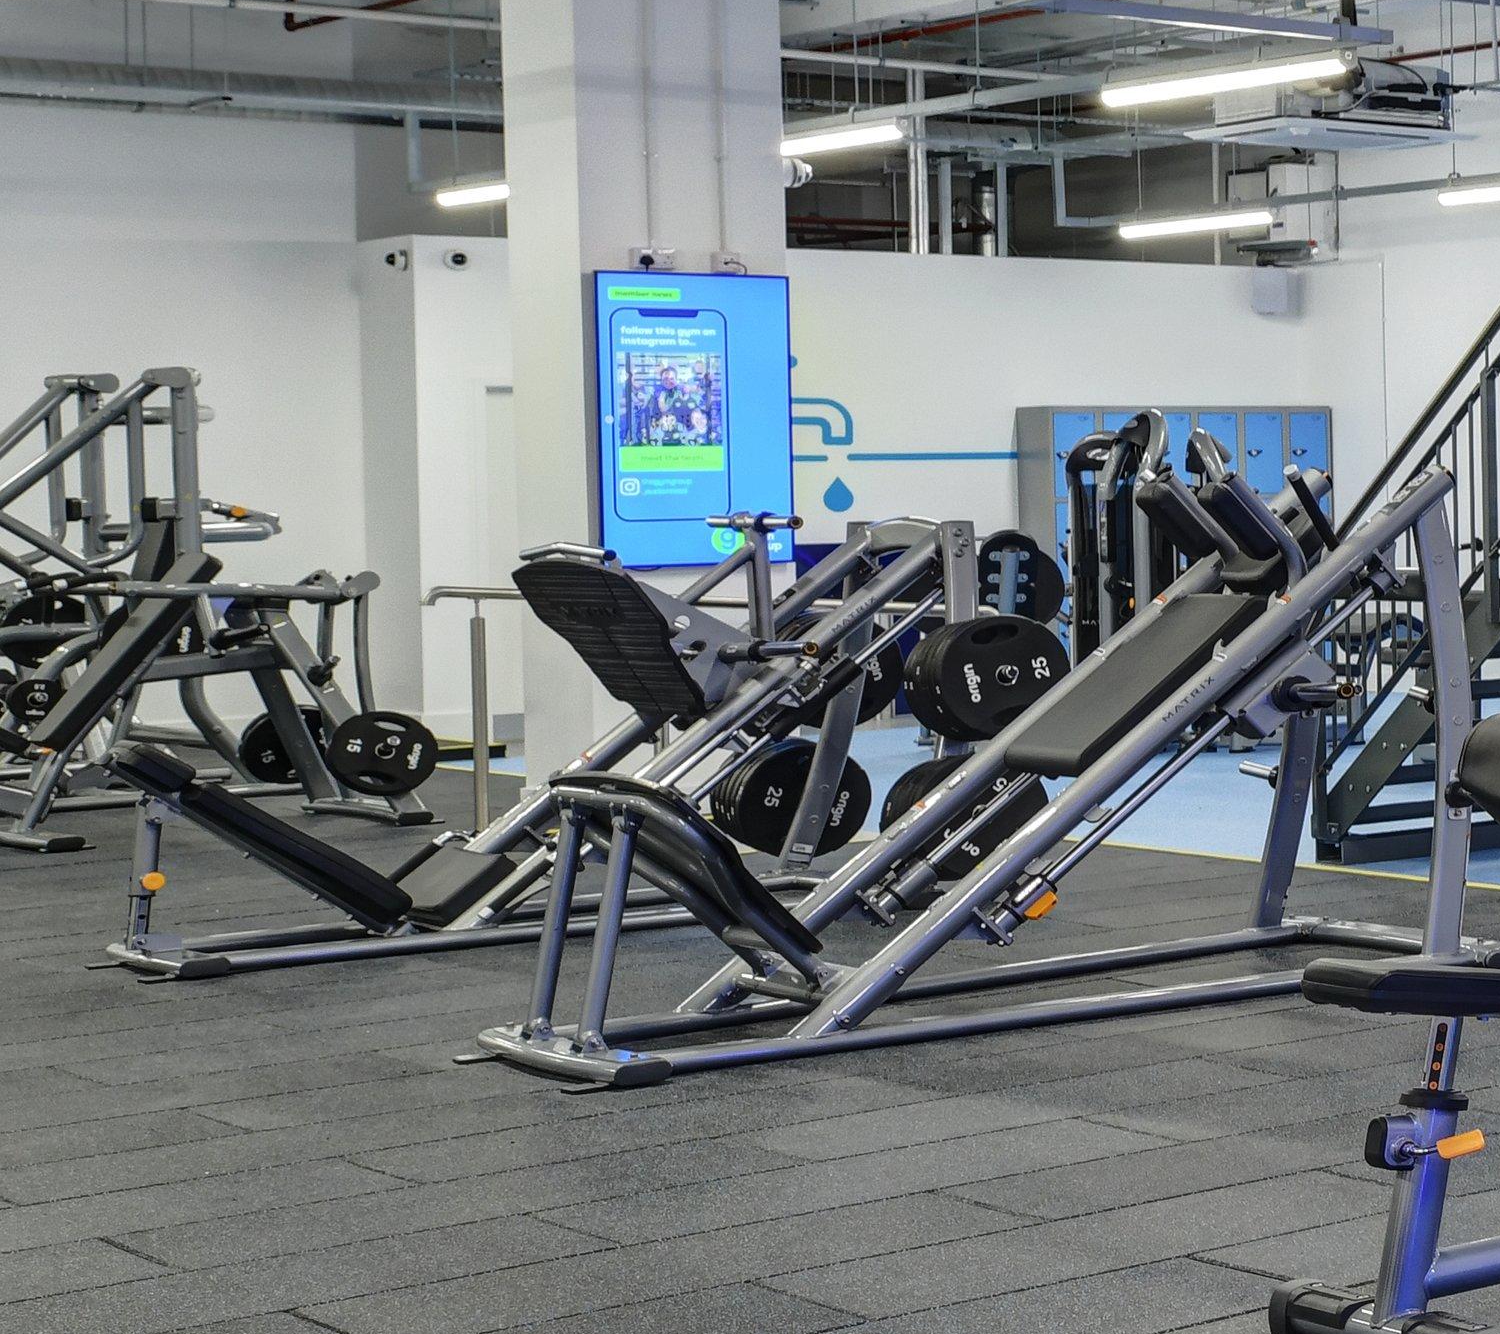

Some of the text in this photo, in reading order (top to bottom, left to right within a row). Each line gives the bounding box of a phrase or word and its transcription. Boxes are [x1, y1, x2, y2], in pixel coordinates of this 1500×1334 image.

[620, 326, 653, 336] follow
[655, 326, 675, 336] this
[677, 329, 700, 338] gym
[620, 336, 676, 347] instagram
[1031, 656, 1051, 679] 25
[963, 663, 982, 703] origin
[1162, 676, 1215, 723] MATRIX
[261, 750, 277, 764] 15
[347, 738, 363, 754] 15
[764, 785, 783, 808] 25
[830, 791, 850, 826] origin
